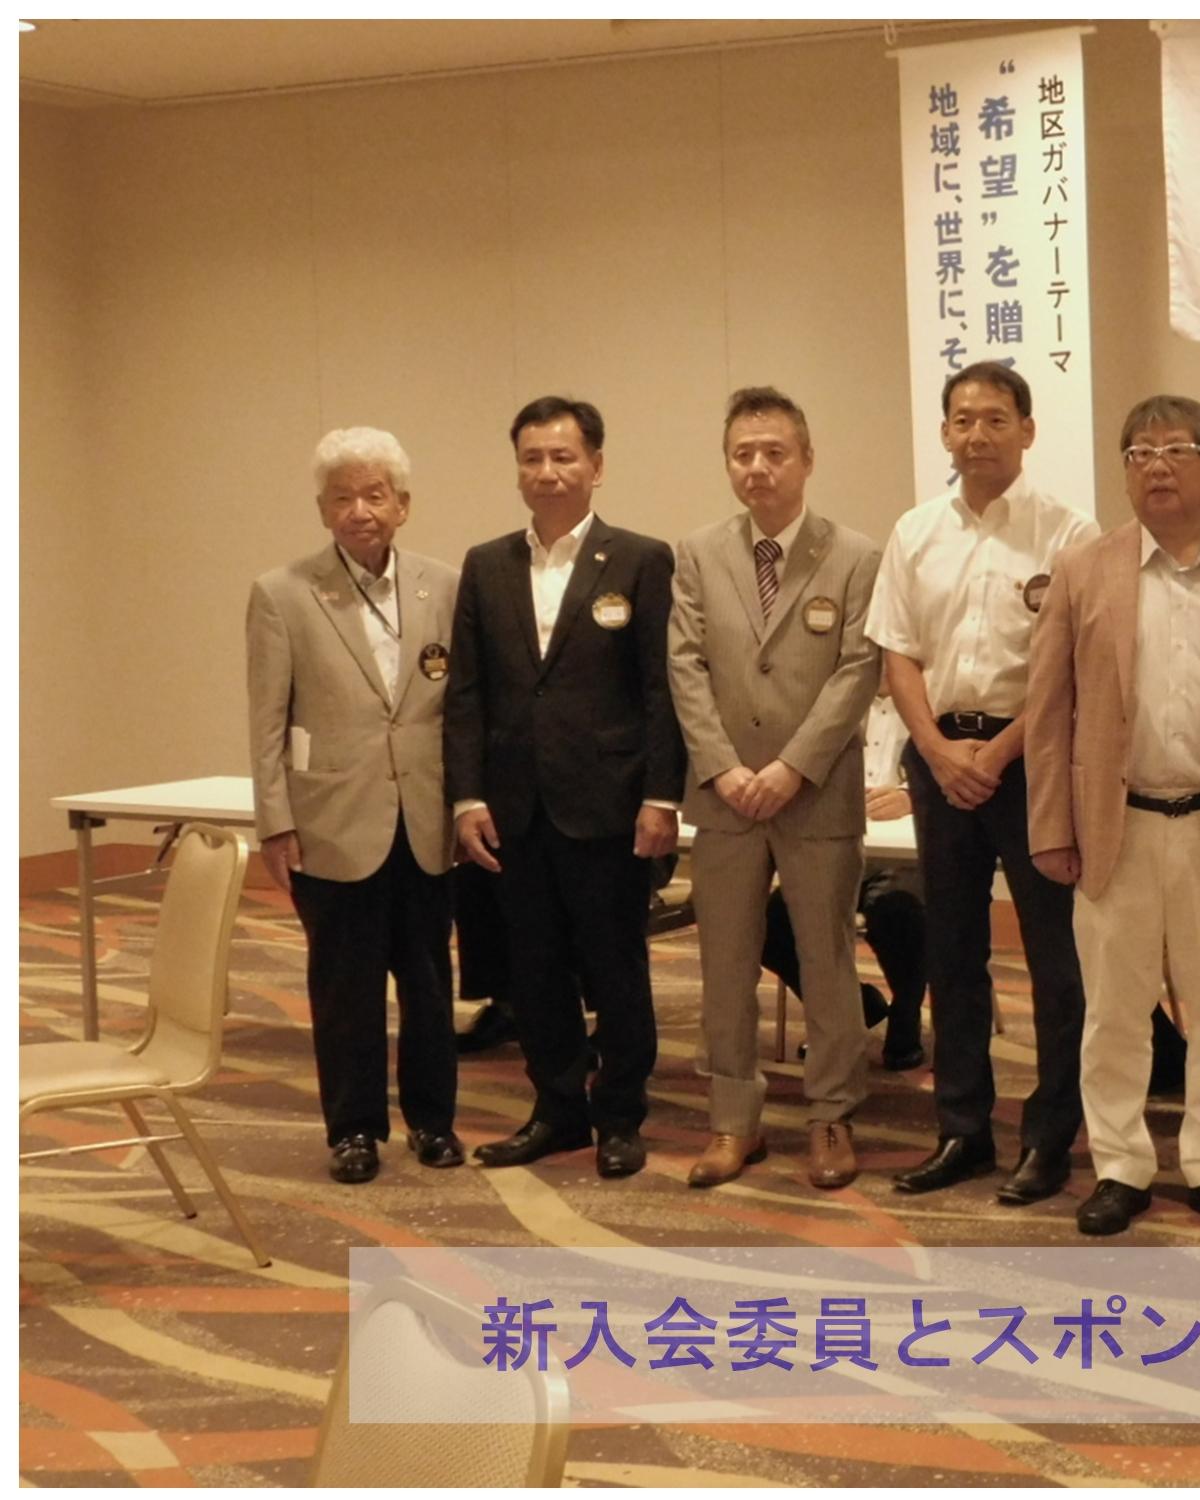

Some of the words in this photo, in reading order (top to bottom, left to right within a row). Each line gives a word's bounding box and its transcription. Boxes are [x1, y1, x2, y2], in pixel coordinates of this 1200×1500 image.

[929, 83, 968, 385] 地域に、世界に、そ
[1038, 75, 1072, 374] 地区ガバナーテーマ
